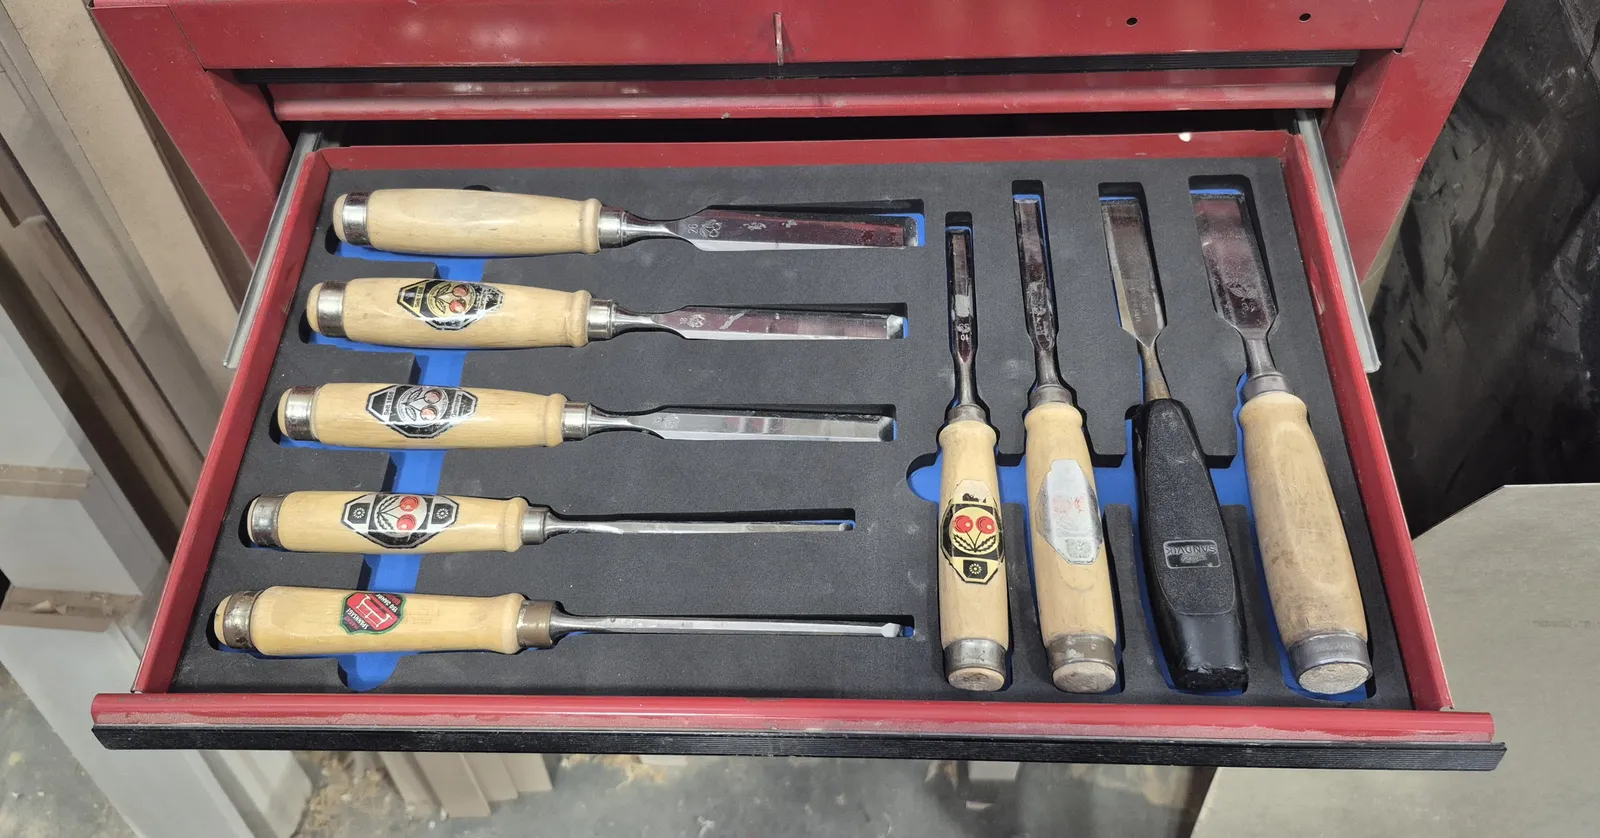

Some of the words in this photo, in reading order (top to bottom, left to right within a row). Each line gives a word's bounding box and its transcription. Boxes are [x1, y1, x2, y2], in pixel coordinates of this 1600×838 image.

[687, 223, 698, 234] 26
[385, 390, 394, 404] 1858
[383, 403, 391, 415] Seit
[450, 393, 461, 417] Germany
[1165, 544, 1216, 554] SANDVIK
